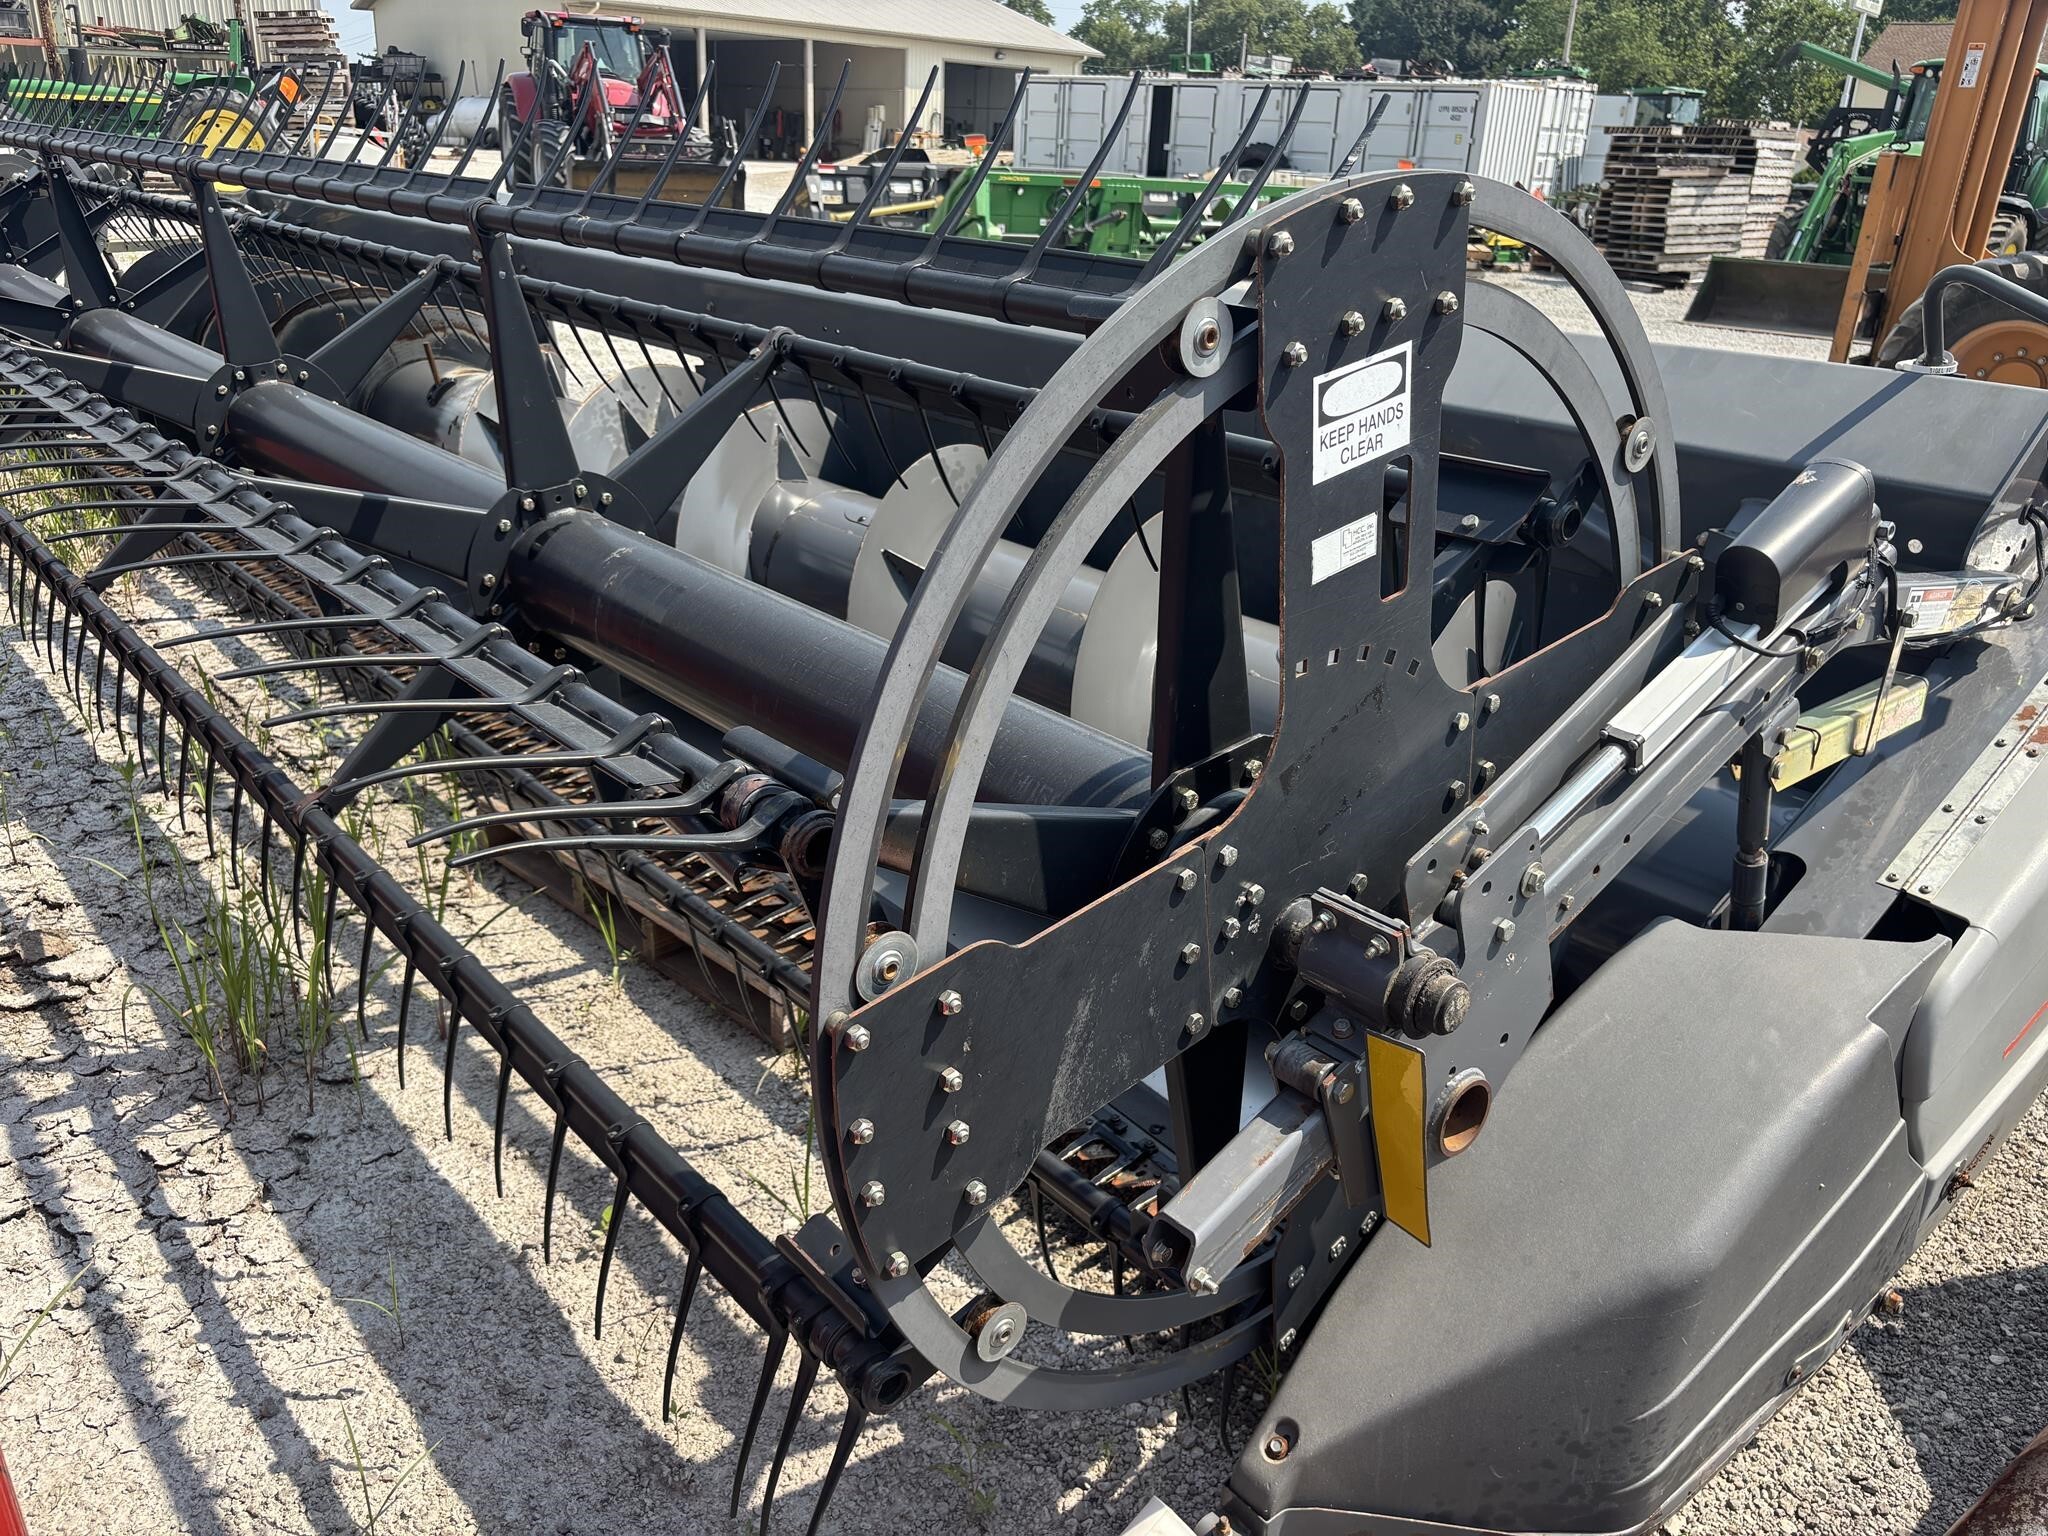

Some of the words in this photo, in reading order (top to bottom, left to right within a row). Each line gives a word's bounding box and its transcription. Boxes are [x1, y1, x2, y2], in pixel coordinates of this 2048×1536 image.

[1319, 422, 1355, 452] KEEP
[1358, 402, 1404, 436] HANDS
[1340, 433, 1383, 464] CLEAR
